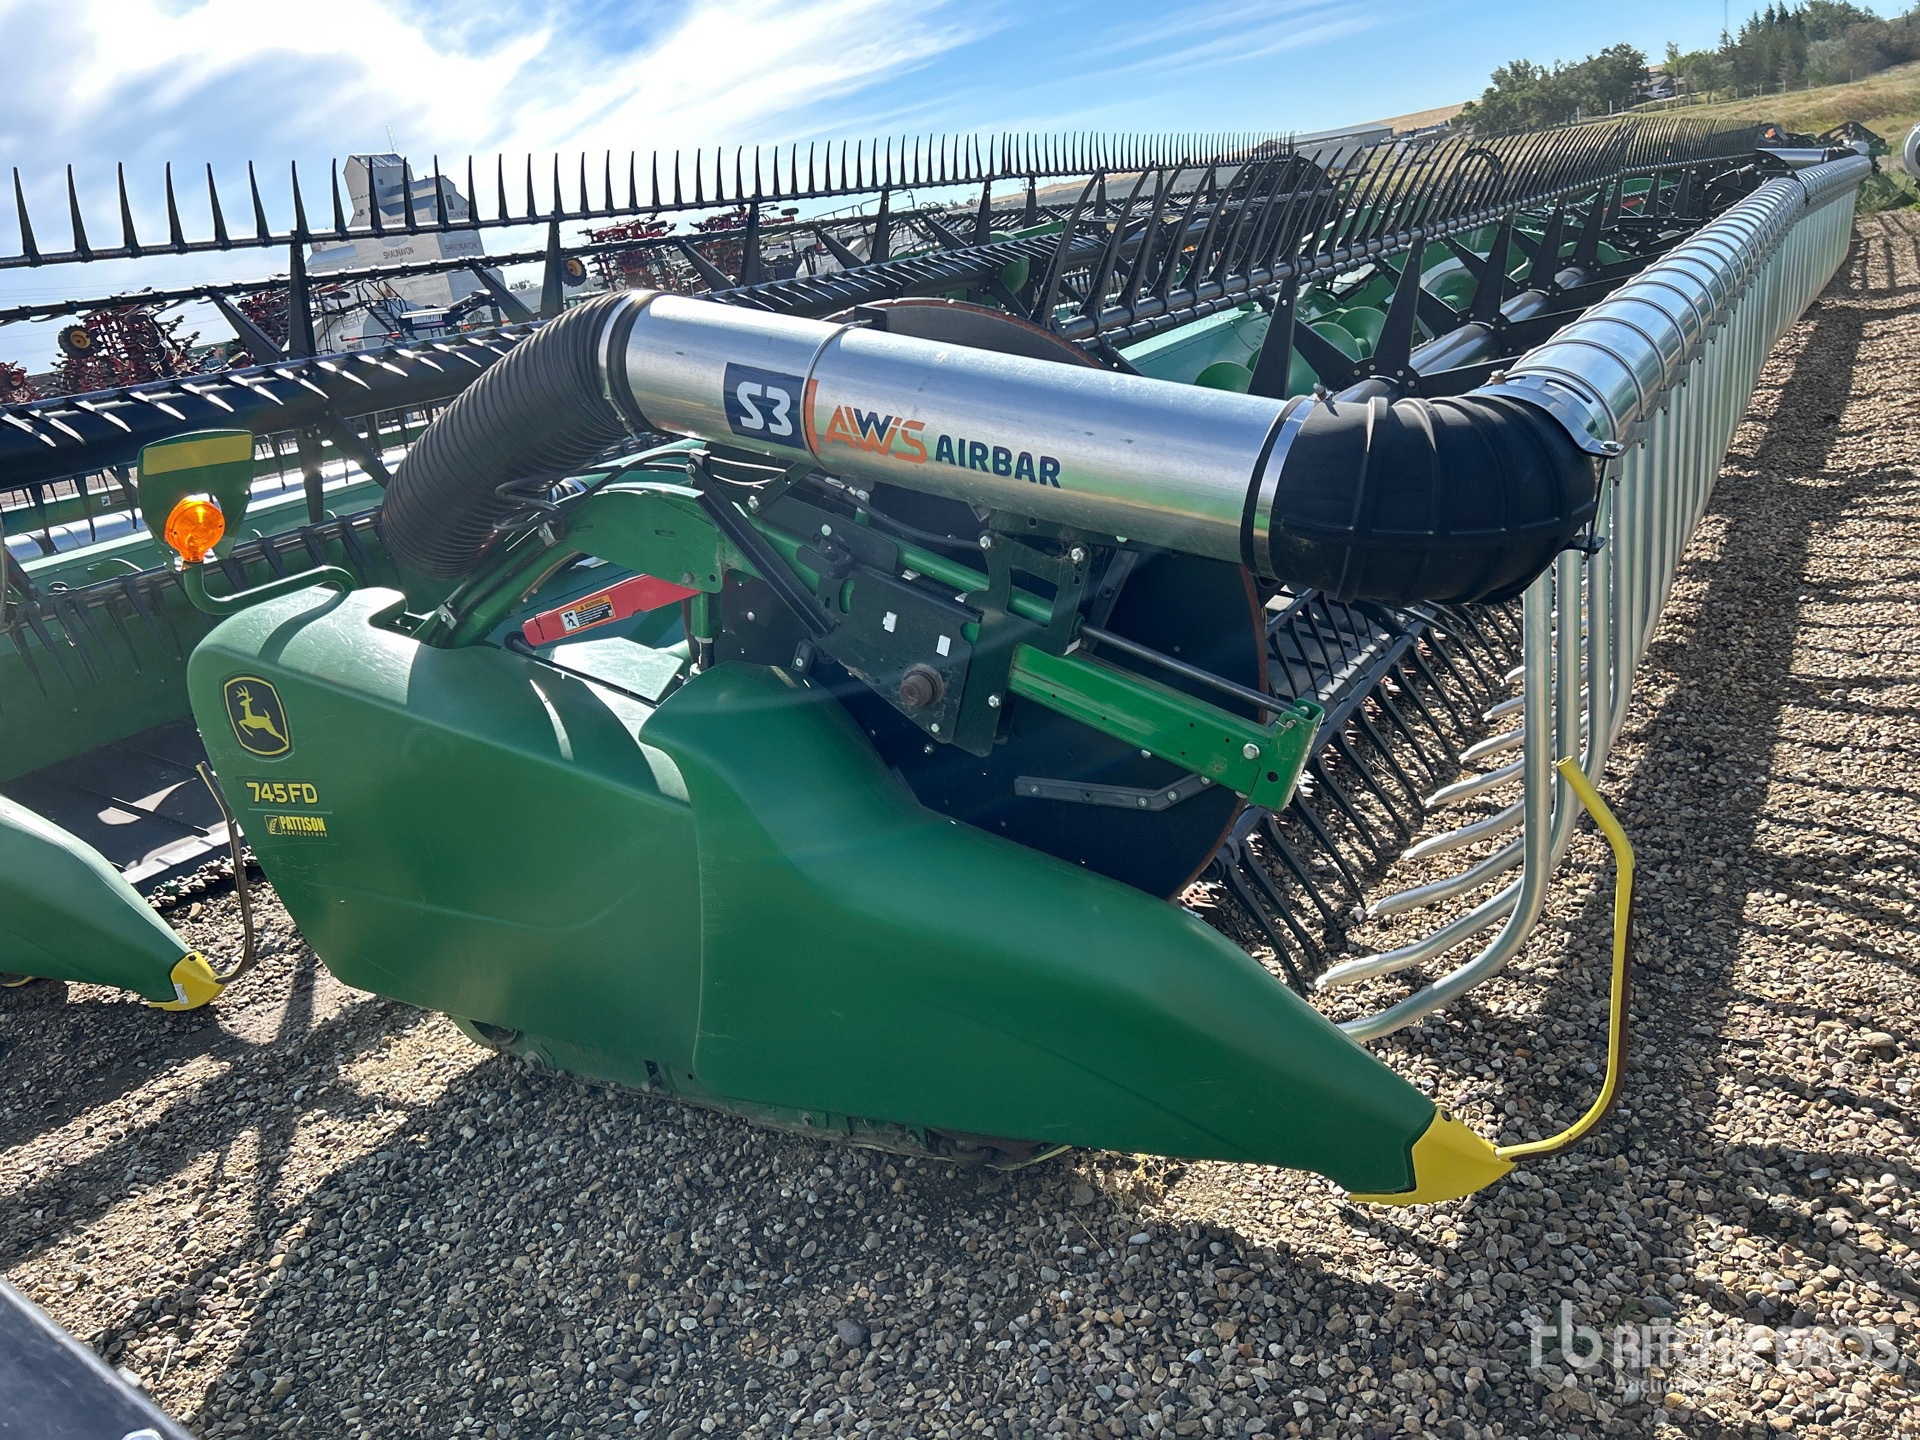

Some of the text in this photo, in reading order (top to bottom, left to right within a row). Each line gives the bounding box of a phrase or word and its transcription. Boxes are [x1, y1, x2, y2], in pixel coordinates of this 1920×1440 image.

[382, 246, 415, 259] SHAUNAVON
[736, 381, 793, 436] S3
[825, 404, 1061, 489] AWS AIRBAR
[584, 598, 605, 609] WARNING
[245, 781, 319, 804] 745FD
[279, 815, 326, 832] PATTISON
